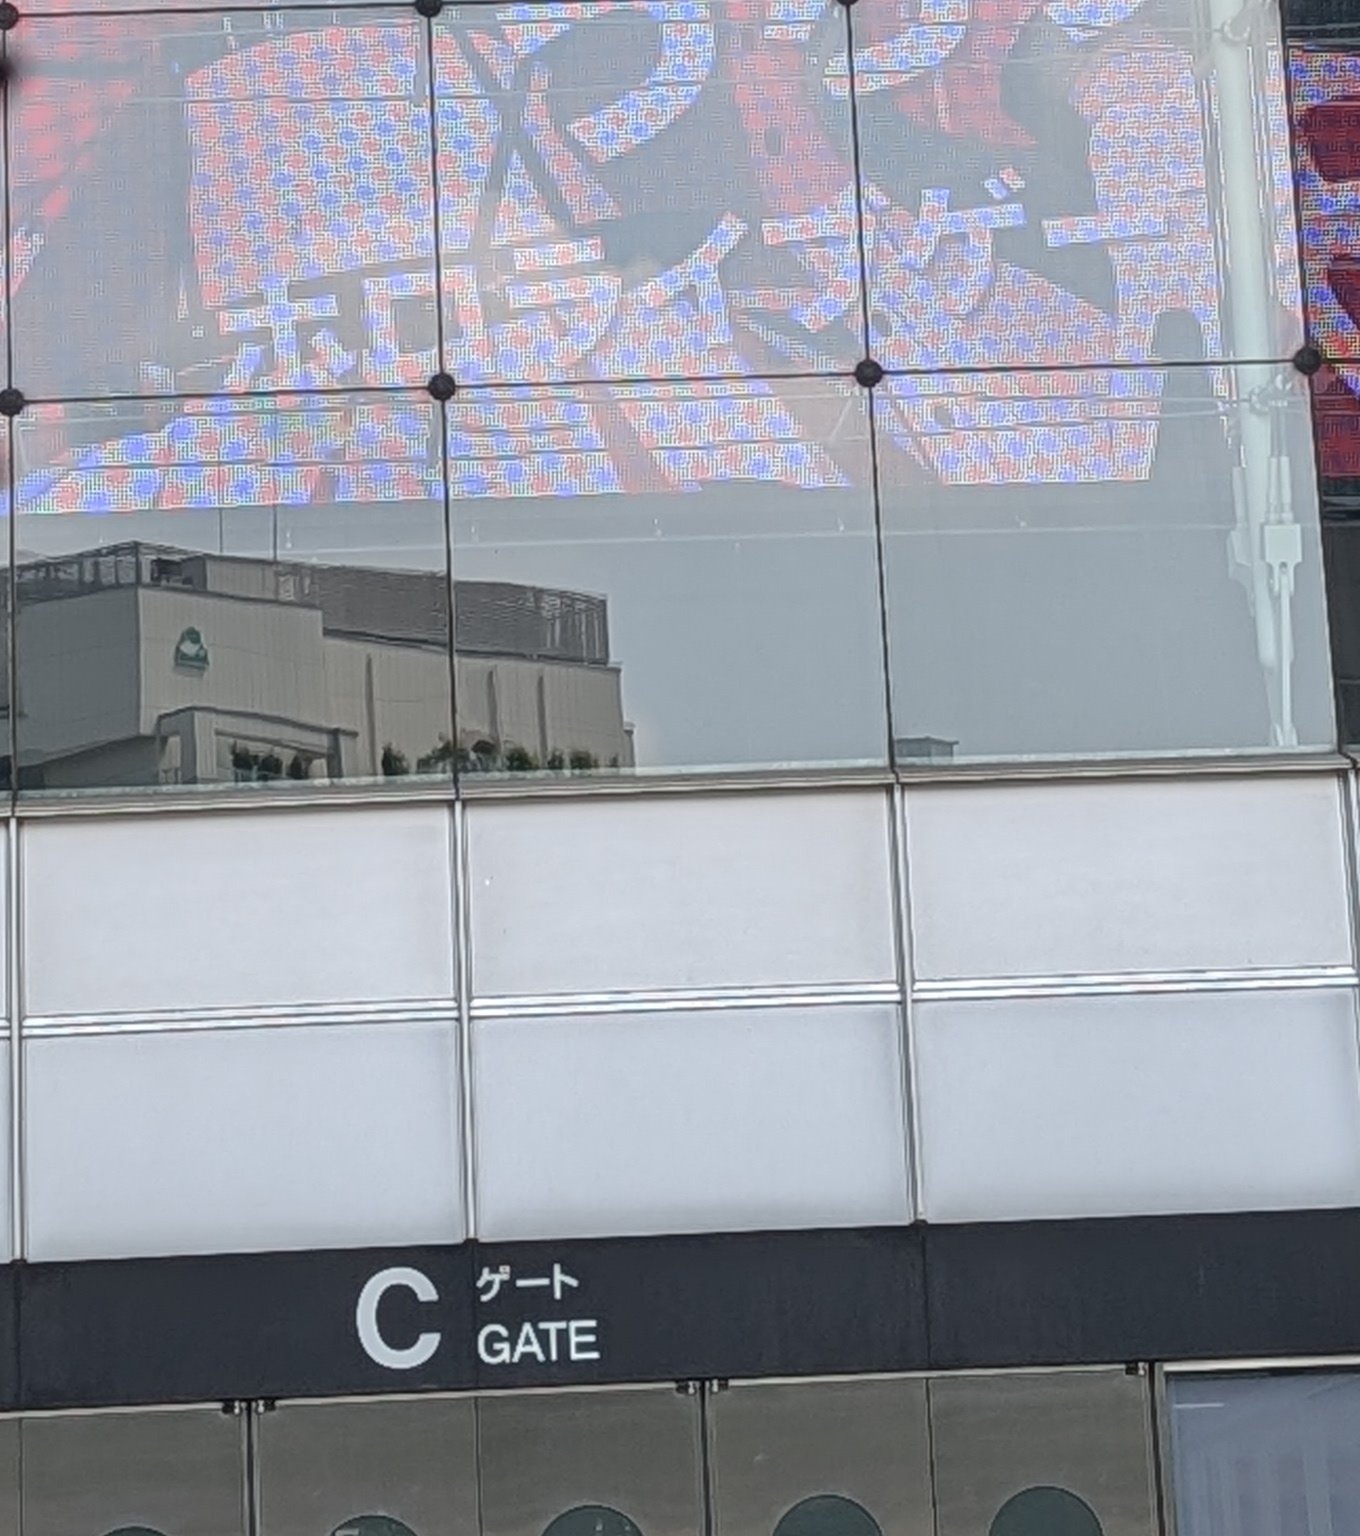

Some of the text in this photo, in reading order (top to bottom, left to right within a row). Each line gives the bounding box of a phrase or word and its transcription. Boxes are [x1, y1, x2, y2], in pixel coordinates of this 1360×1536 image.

[476, 1263, 579, 1302] ゲート
[355, 1266, 441, 1369] C
[477, 1319, 600, 1364] GATE
